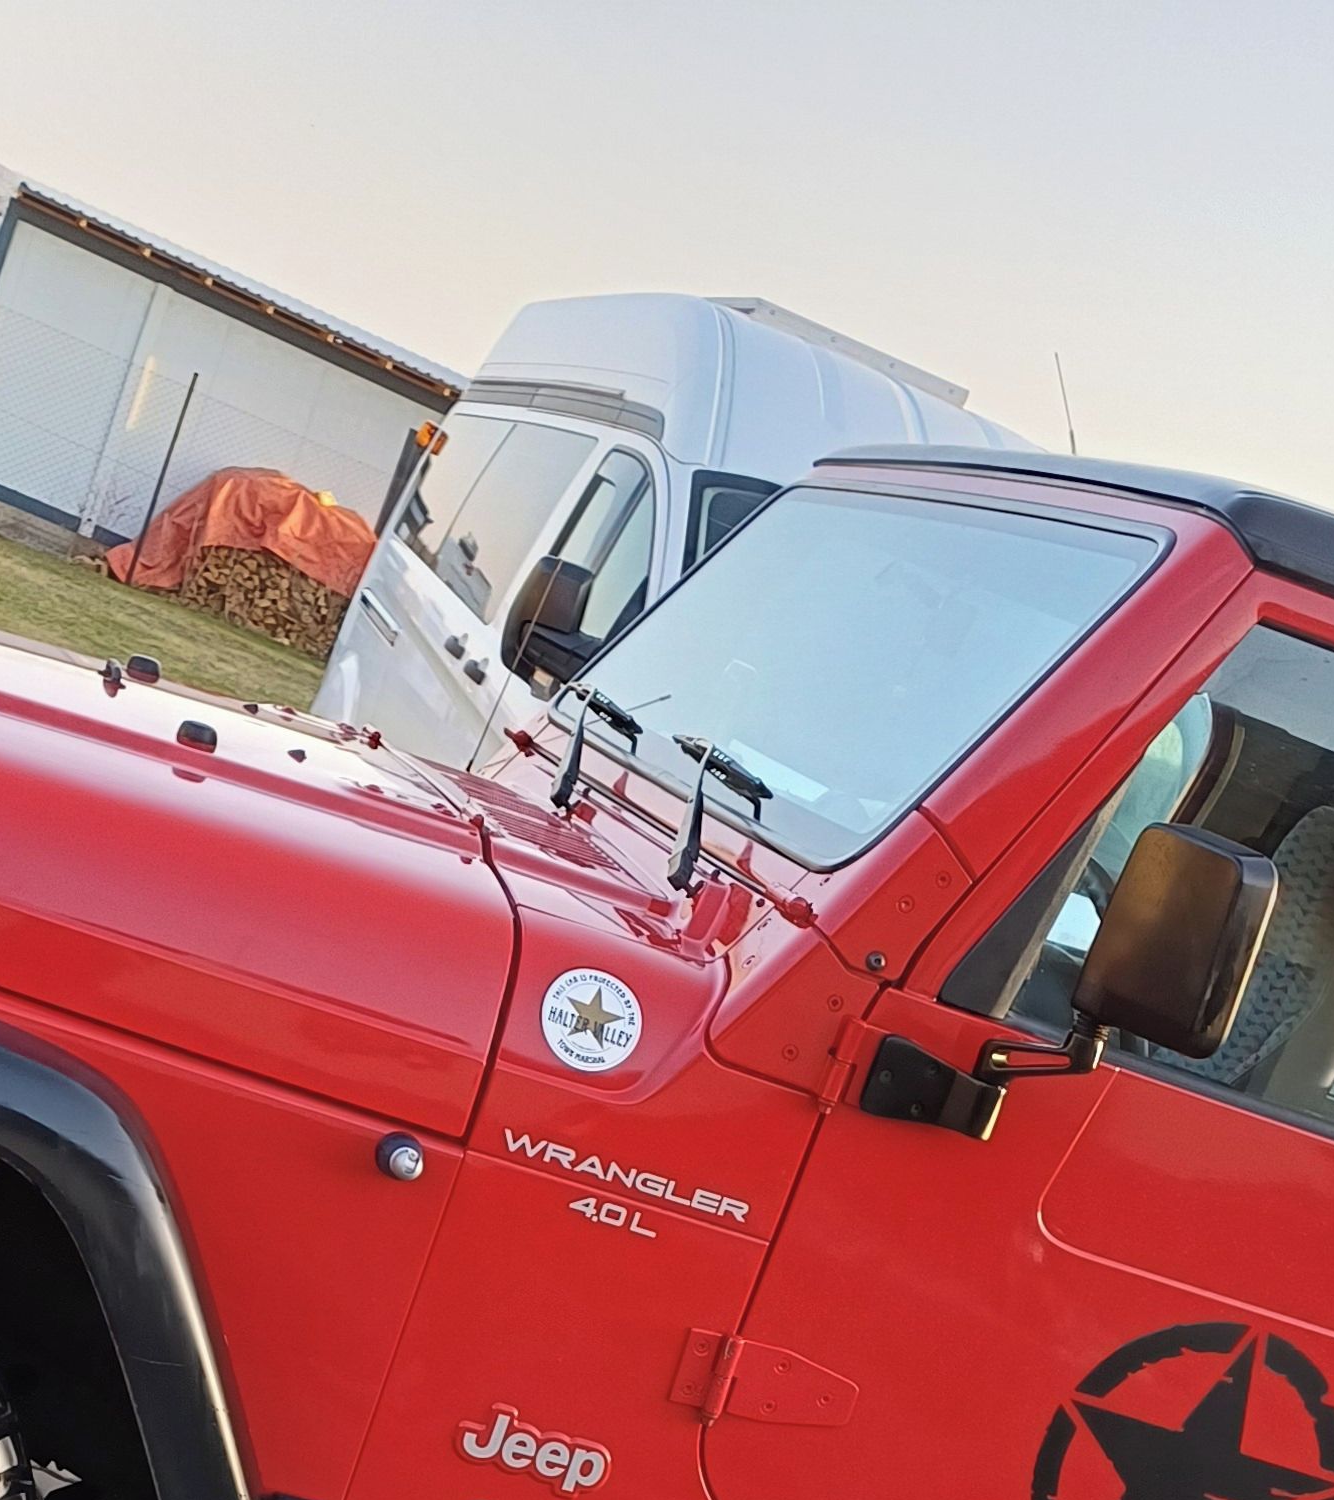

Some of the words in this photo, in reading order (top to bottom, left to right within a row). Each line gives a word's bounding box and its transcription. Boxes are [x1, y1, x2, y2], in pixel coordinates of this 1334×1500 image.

[547, 1005, 590, 1036] HALTER
[504, 1127, 750, 1224] WRANGLER
[462, 1413, 606, 1493] Jeep
